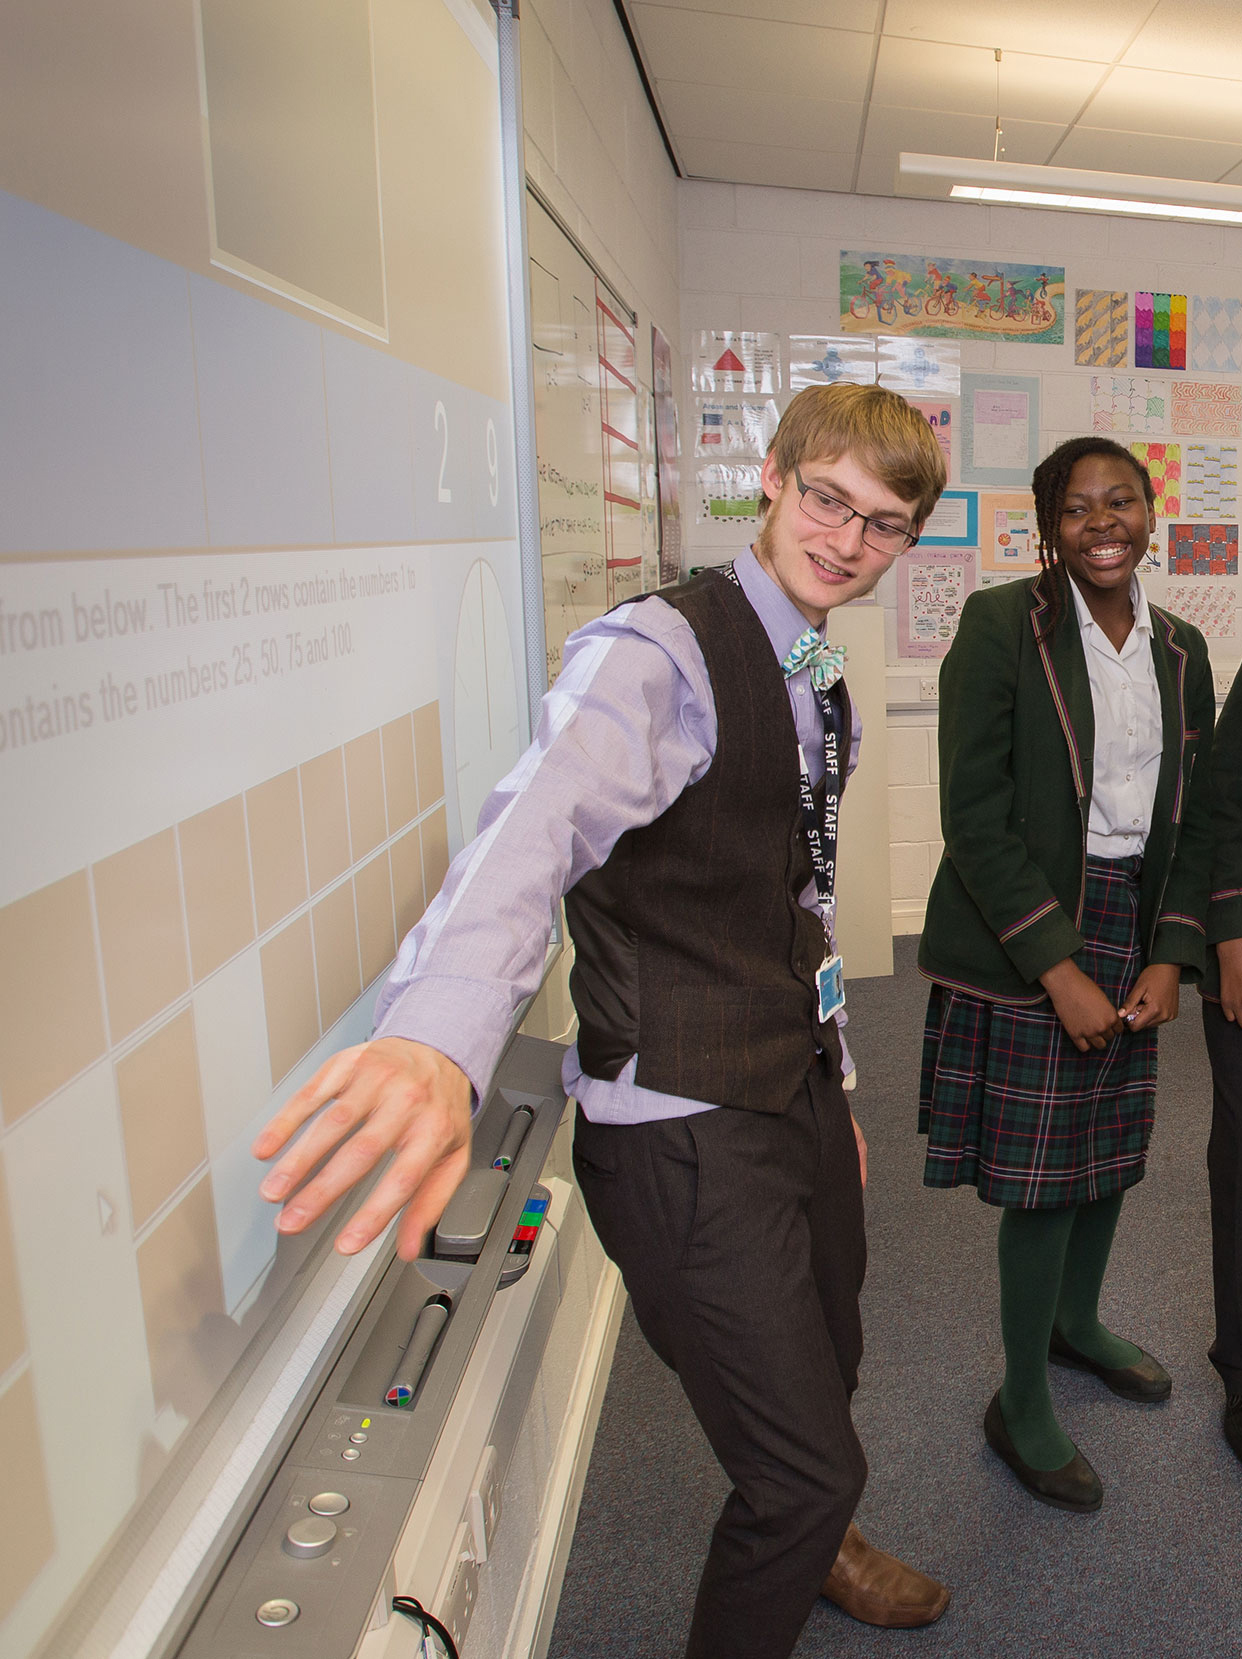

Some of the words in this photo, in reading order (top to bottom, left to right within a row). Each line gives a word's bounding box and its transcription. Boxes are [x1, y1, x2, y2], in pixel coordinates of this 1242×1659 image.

[434, 400, 451, 503] 2
[487, 417, 499, 507] 9
[71, 588, 154, 643] below.
[157, 580, 199, 628] The
[202, 578, 238, 622] first
[239, 576, 252, 618] 2
[254, 582, 290, 615] rows
[293, 569, 337, 609] contain
[340, 567, 356, 600] the
[358, 564, 399, 598] numbers
[407, 565, 416, 590] to
[0, 682, 94, 752] ontains
[99, 671, 139, 723] the
[145, 655, 229, 711] numbers
[232, 643, 257, 687] 25,
[260, 636, 284, 677] 50,
[286, 631, 303, 671] 75
[306, 625, 329, 665] and
[824, 732, 839, 776] STAFF
[800, 774, 815, 811] TAFF
[824, 794, 838, 841] STAFF
[807, 829, 826, 873] STAFF
